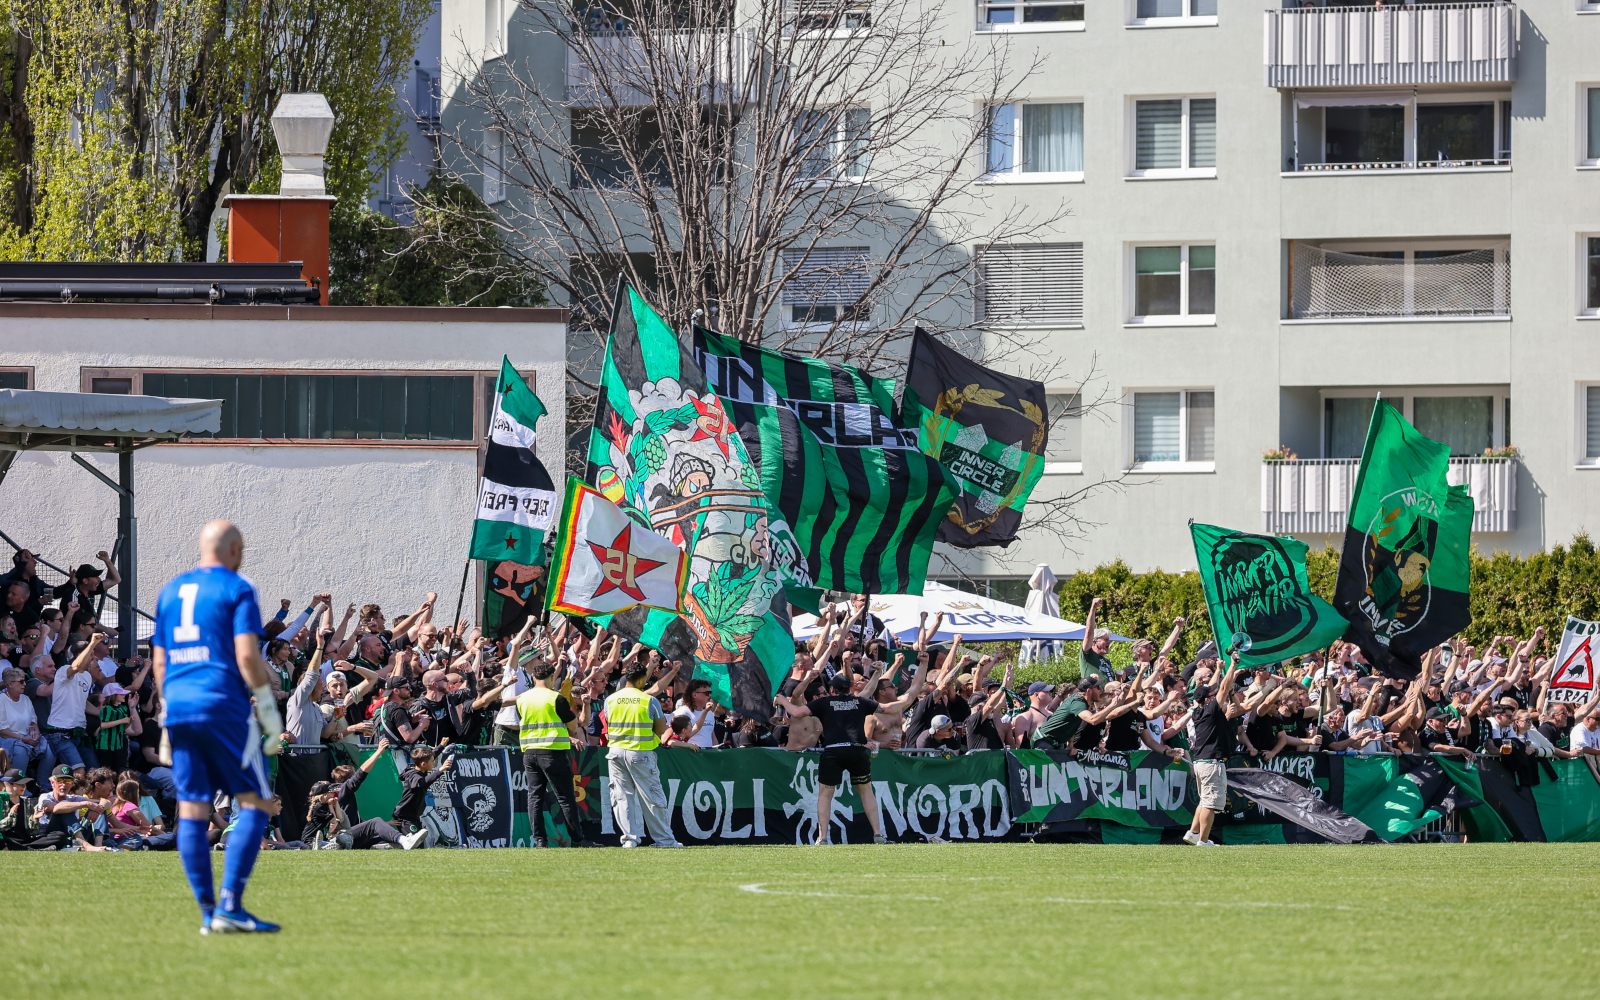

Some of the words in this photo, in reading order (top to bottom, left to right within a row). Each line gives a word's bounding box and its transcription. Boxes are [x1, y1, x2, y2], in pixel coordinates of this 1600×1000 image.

[949, 460, 1004, 493] CIRCLE
[958, 450, 1006, 479] INNER
[173, 582, 200, 643] 1
[936, 610, 1033, 628] Zipfer
[1566, 619, 1600, 636] VIO
[616, 697, 641, 705] ORDNER
[1029, 760, 1188, 811] UNTERLAND
[599, 776, 769, 840] VOLI
[871, 778, 1011, 840] NORD
